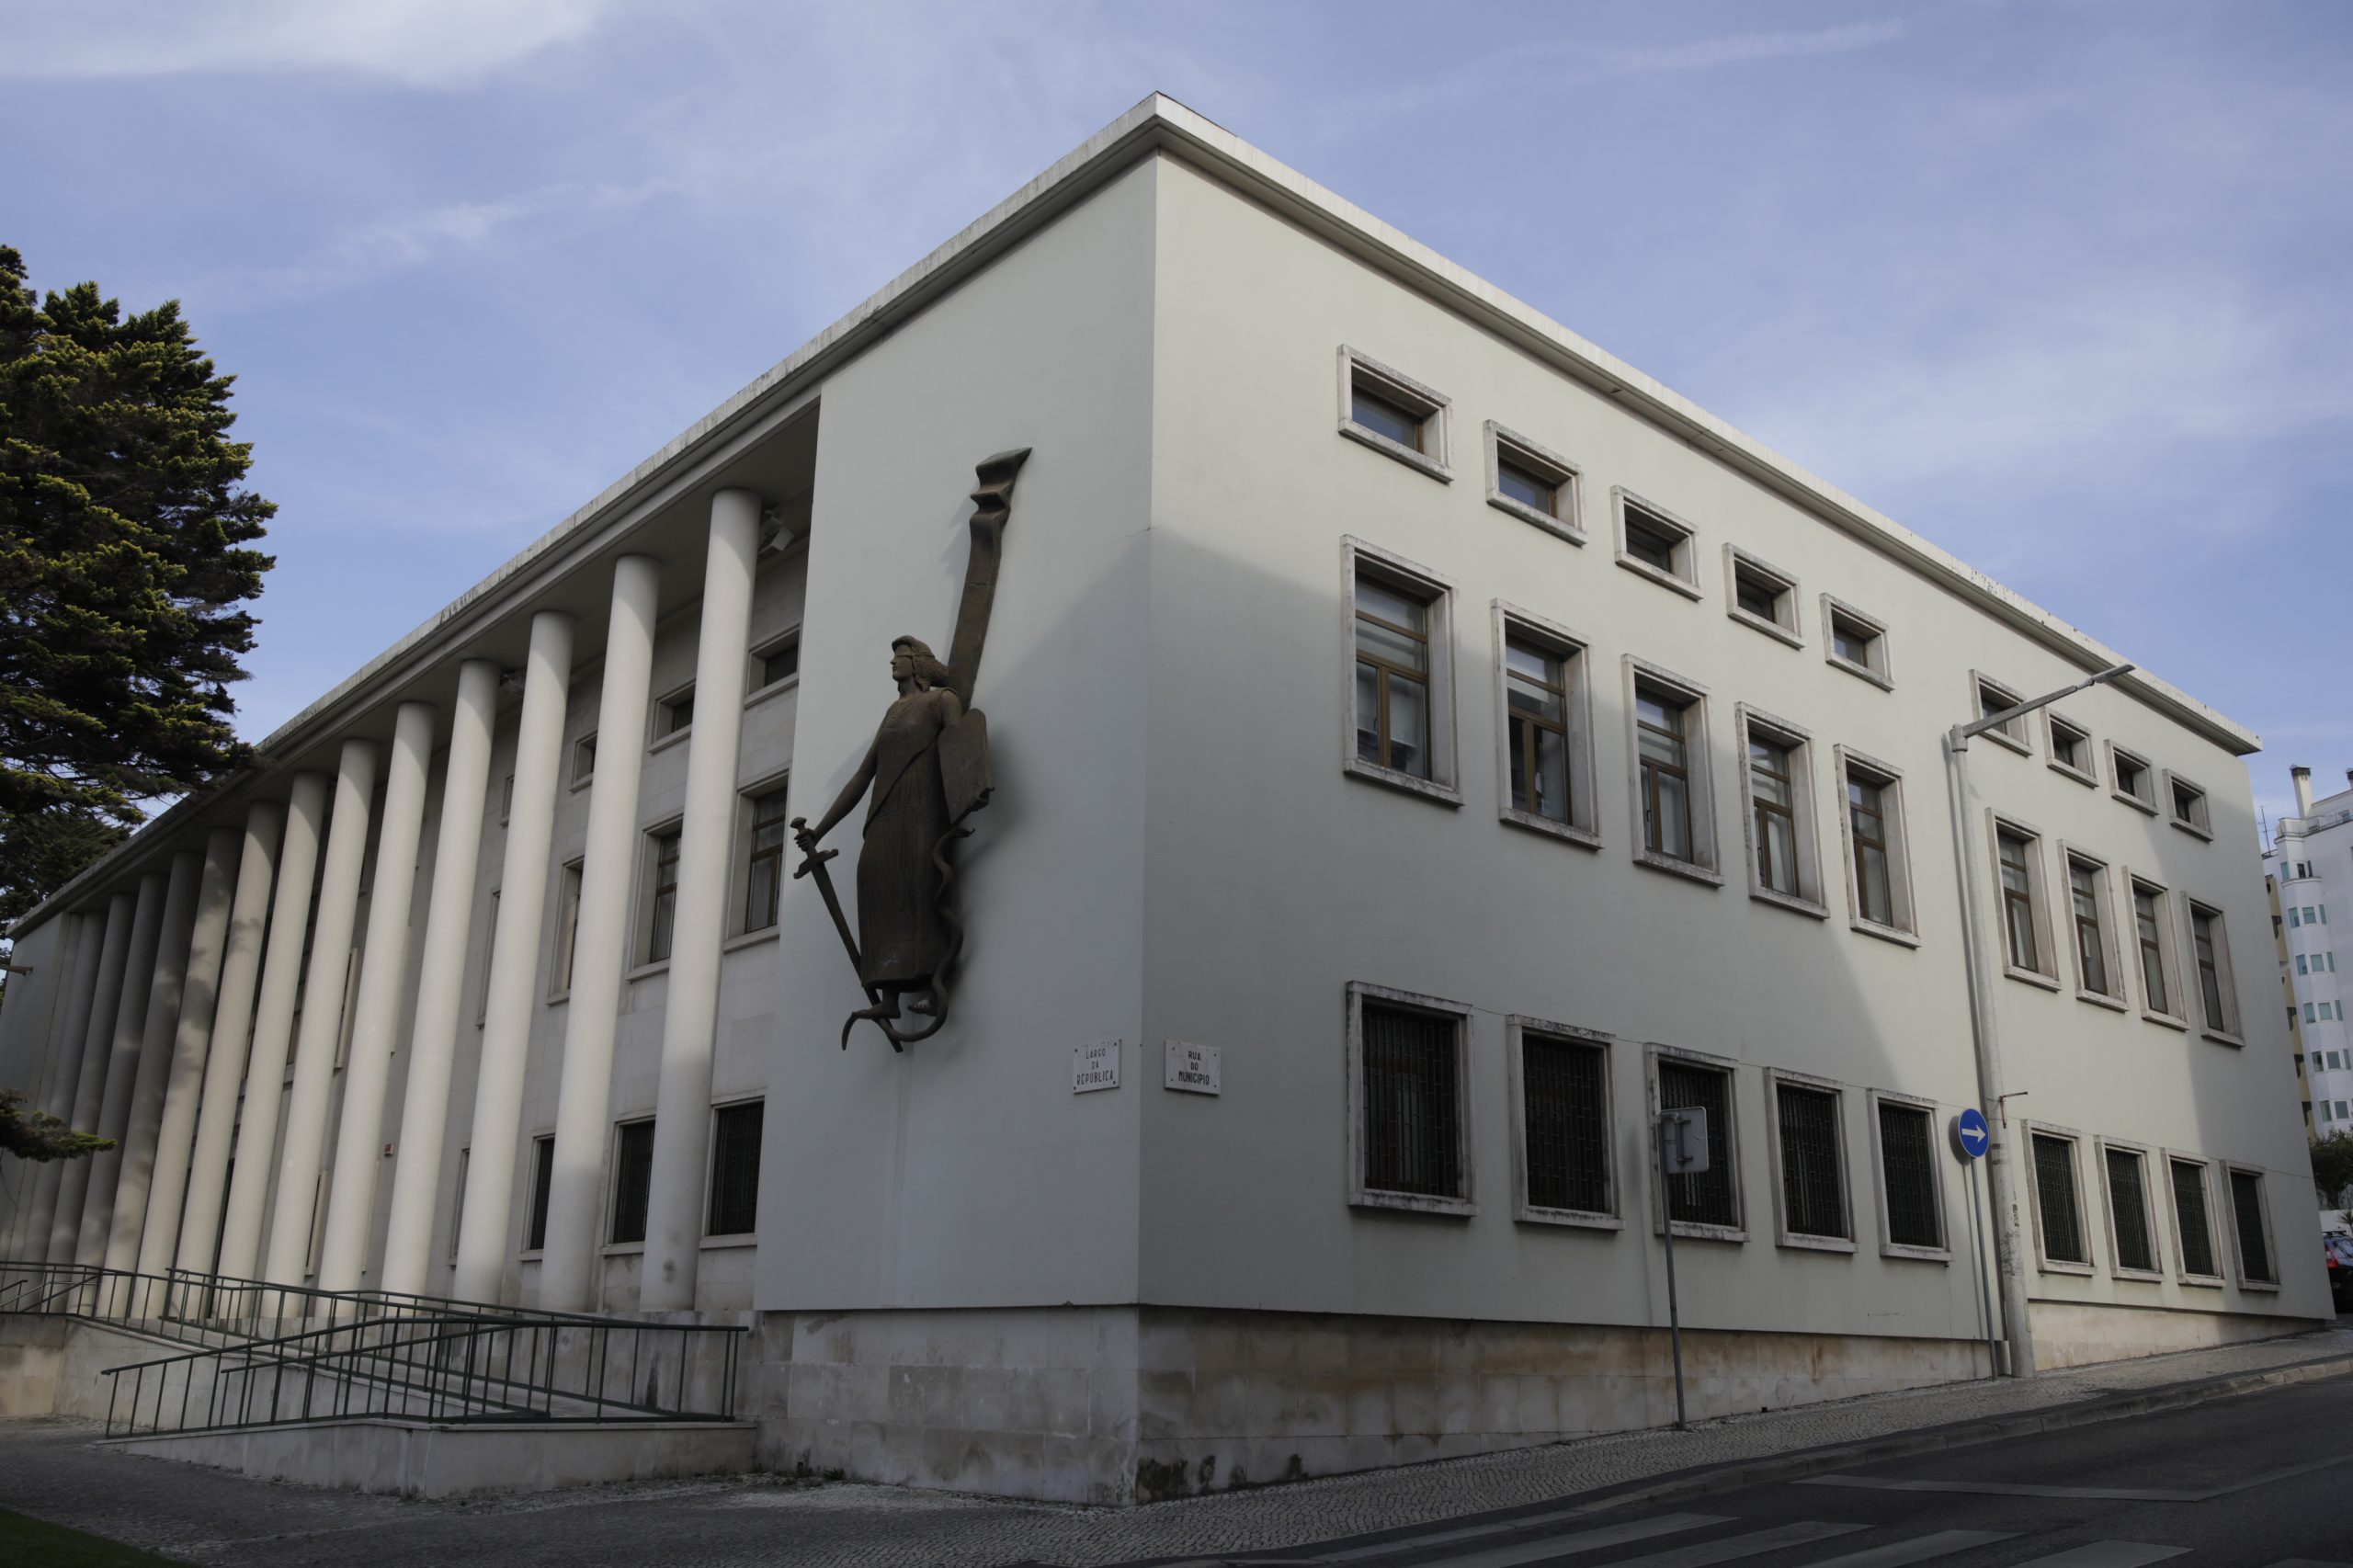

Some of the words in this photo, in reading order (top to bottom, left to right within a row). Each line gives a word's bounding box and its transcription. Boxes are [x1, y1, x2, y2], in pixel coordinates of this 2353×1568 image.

[1086, 1048, 1106, 1059] LARGO
[1188, 1051, 1201, 1061] RUA
[1091, 1060, 1099, 1070] DA
[1190, 1062, 1199, 1071] DO
